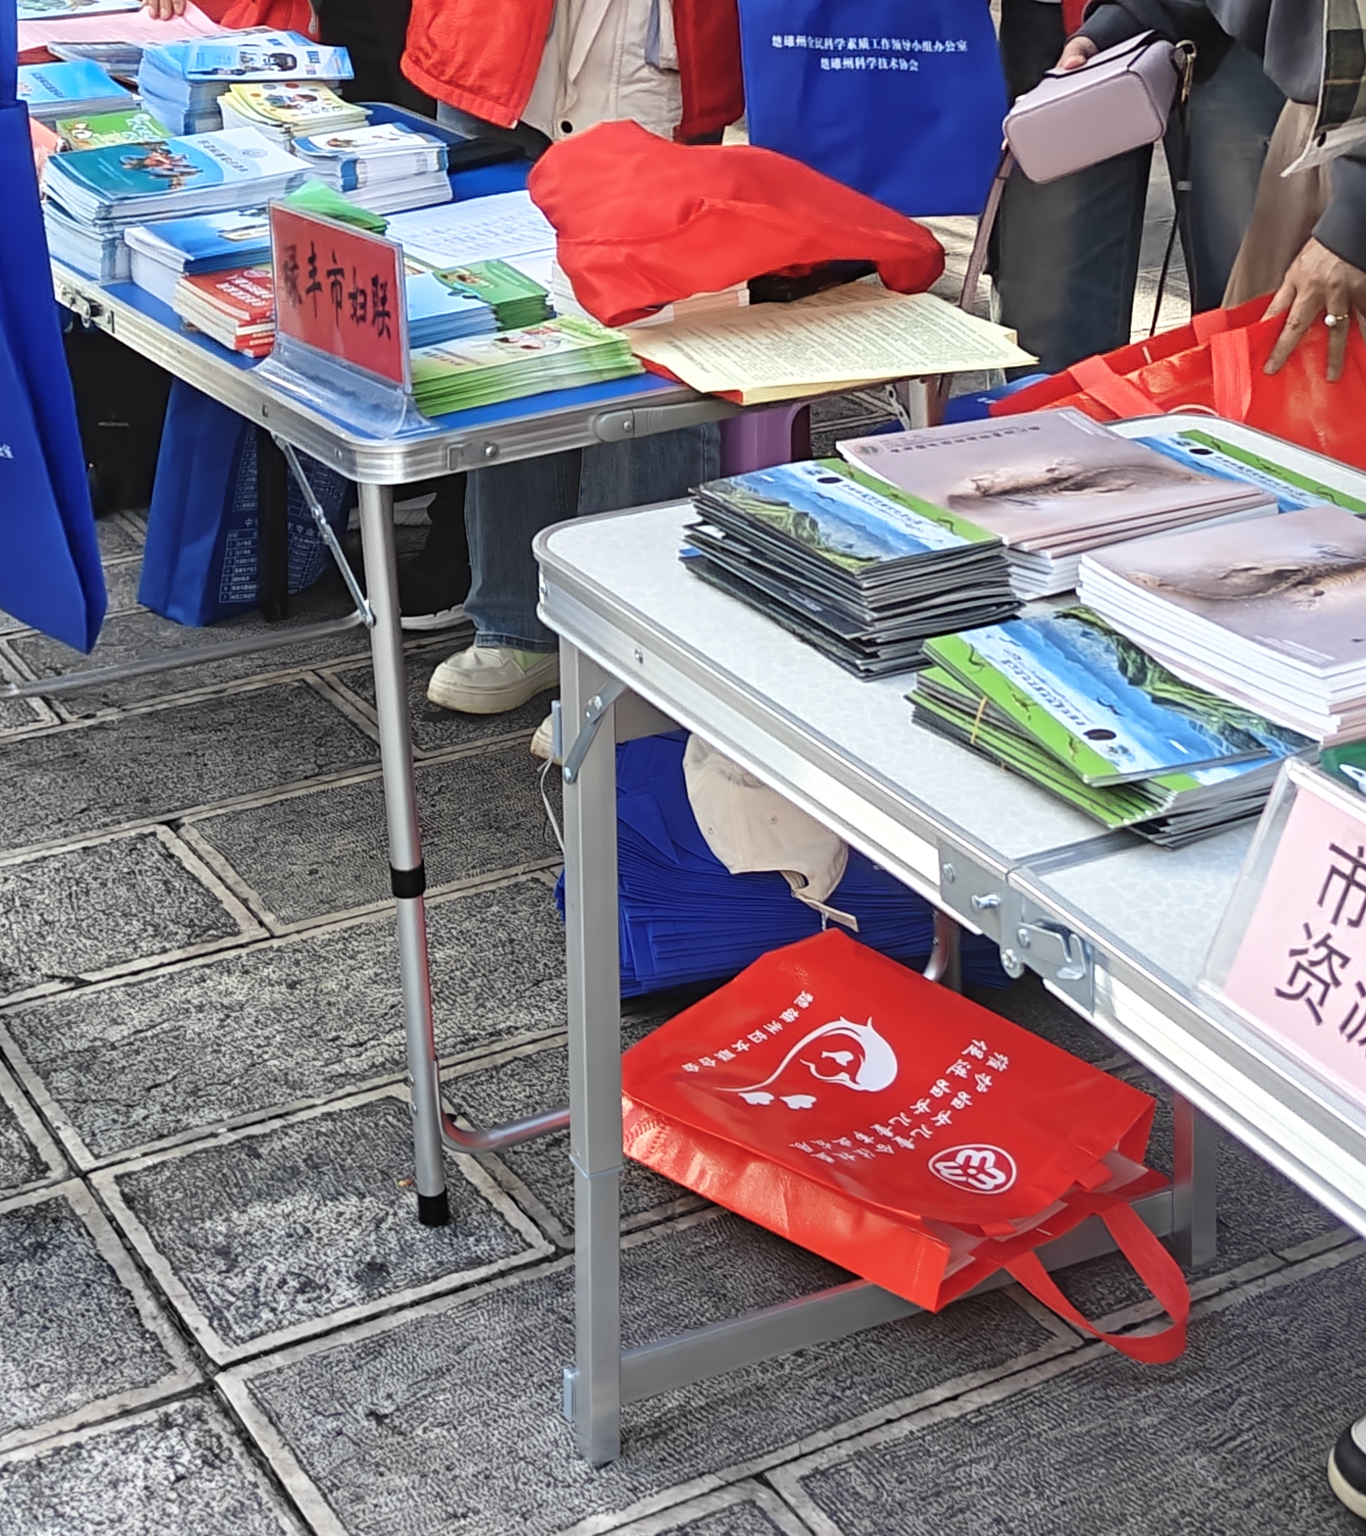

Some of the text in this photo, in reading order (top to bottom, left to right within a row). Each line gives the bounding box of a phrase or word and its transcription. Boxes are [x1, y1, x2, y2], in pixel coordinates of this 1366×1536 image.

[819, 56, 920, 72] 楚雄州科学技术协会
[286, 241, 392, 341] 禄丰市妇联
[682, 989, 815, 1073] 楚雄州妇女联合会
[809, 1050, 1010, 1164] 维护妇女儿童合法权益
